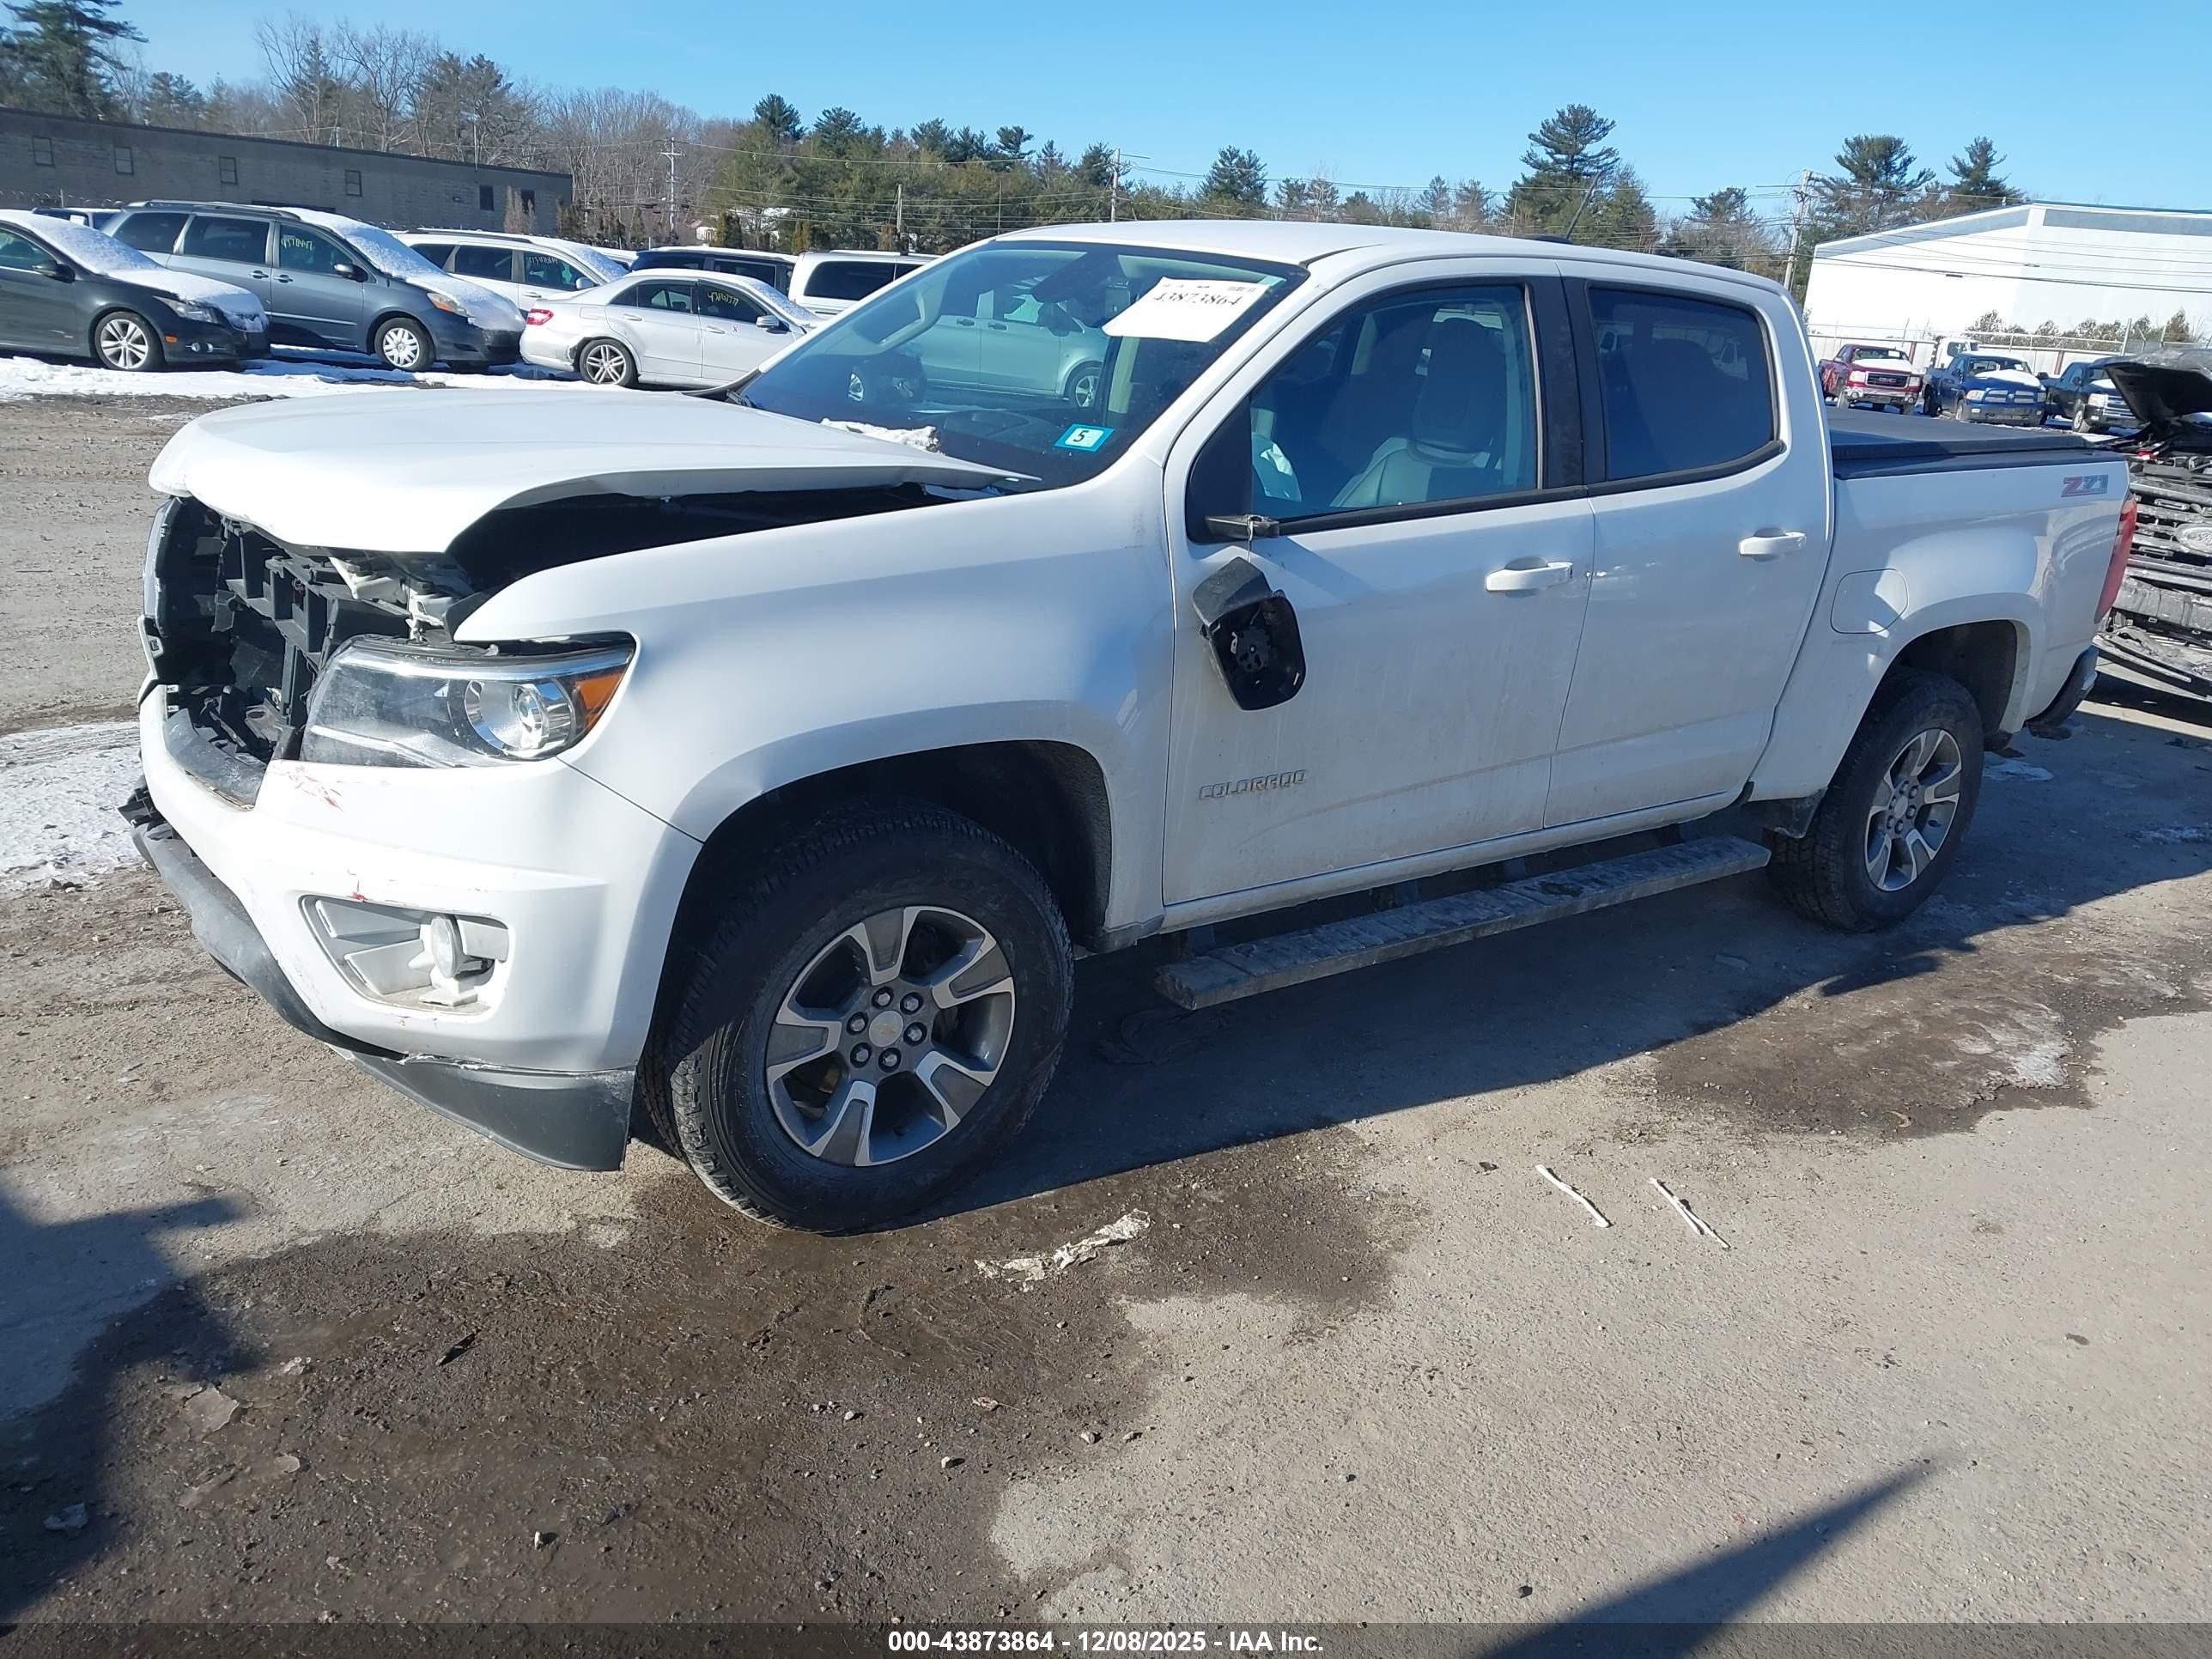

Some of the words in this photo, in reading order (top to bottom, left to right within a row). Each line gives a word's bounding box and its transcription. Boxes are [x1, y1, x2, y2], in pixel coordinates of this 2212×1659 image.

[1073, 429, 1090, 442] 5
[2061, 474, 2109, 498] Z71
[1199, 769, 1307, 801] COLORADO
